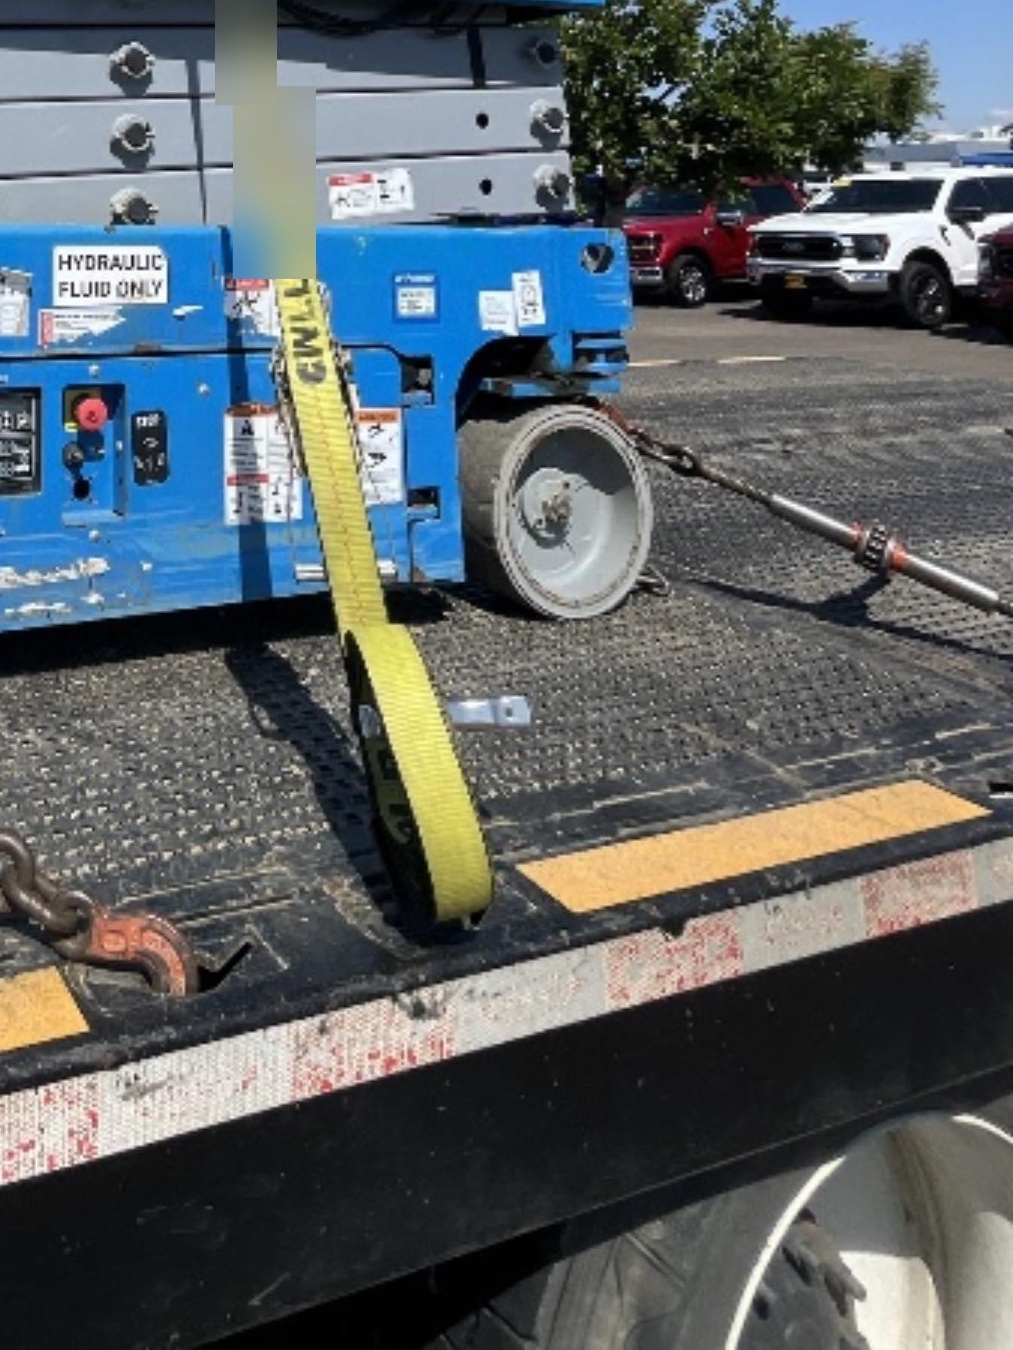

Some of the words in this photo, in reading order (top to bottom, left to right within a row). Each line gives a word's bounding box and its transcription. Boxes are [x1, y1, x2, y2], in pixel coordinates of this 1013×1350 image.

[58, 254, 164, 271] HYDRAULIC
[58, 281, 111, 298] FLUID
[115, 279, 163, 298] ONLY
